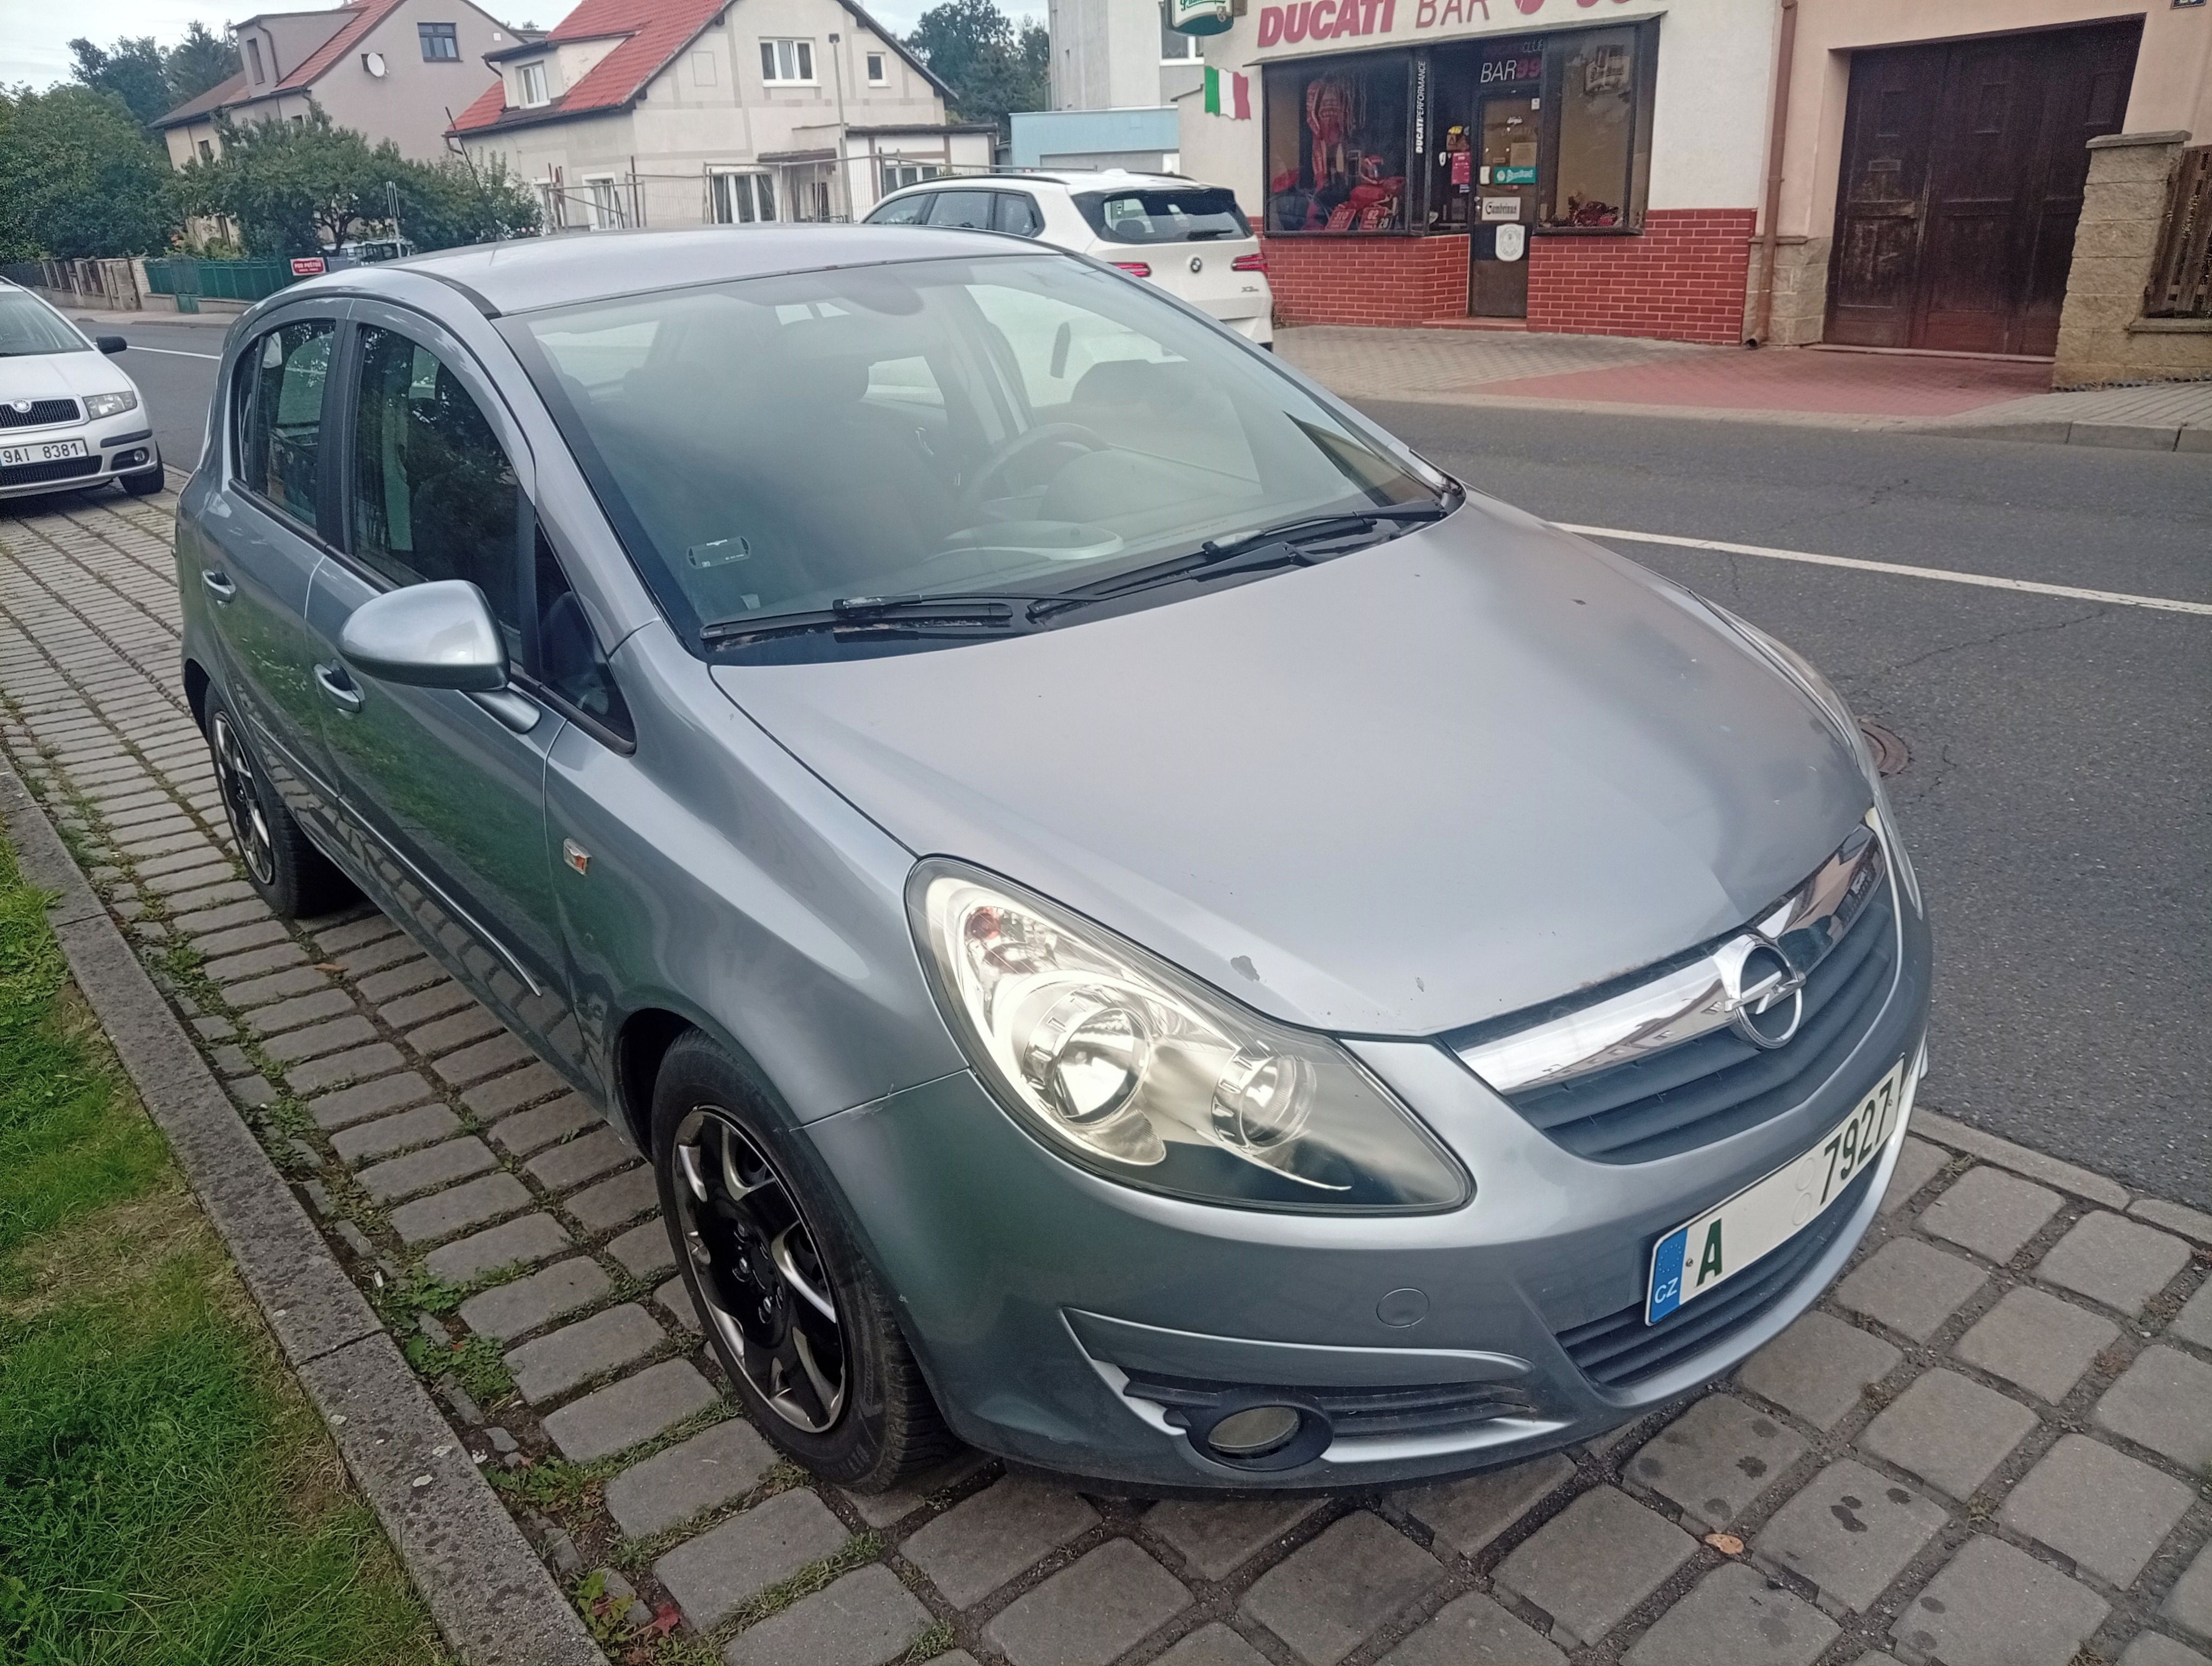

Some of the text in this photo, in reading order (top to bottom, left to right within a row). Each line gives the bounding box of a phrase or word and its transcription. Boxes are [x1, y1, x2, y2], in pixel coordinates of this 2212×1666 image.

[1257, 0, 1490, 48] DUCATI BAR
[3, 443, 79, 463] 9AI 8381
[1696, 1076, 1894, 1287] A 7927
[1655, 1277, 1679, 1304] CZ
